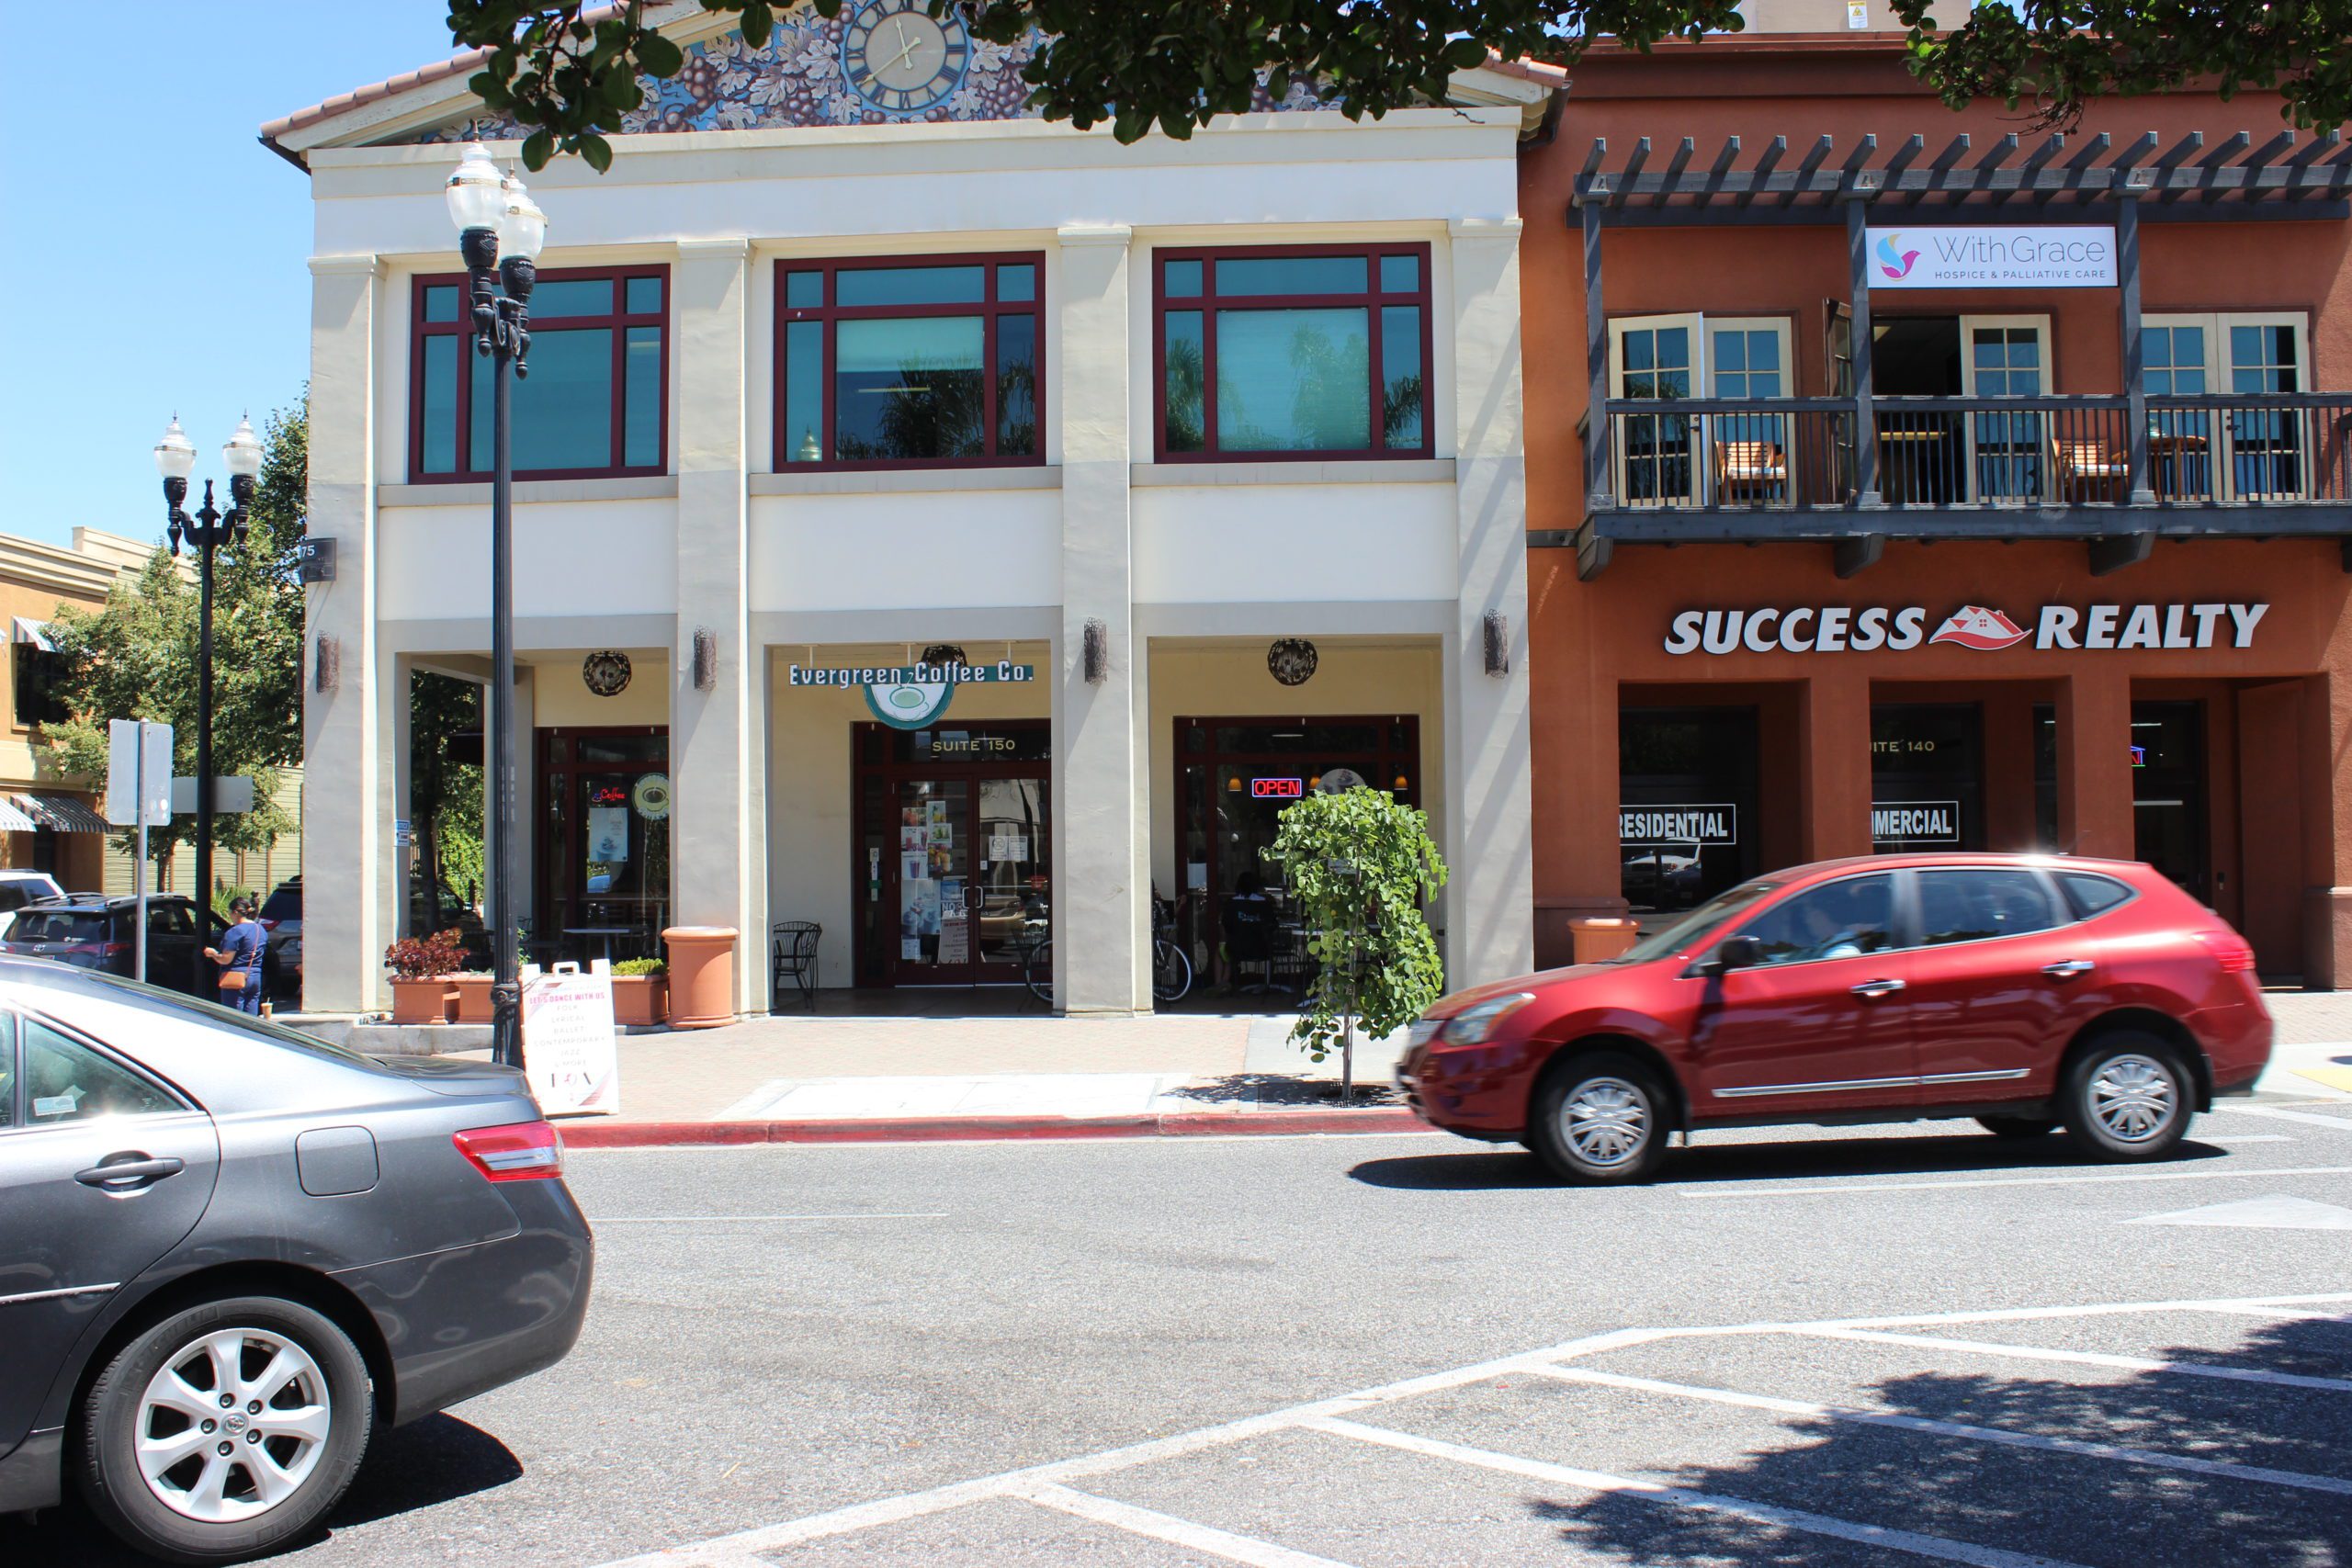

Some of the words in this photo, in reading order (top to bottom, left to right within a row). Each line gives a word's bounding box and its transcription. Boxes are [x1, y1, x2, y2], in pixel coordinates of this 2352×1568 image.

[1935, 270, 1985, 280] HOSPICE
[1991, 270, 1997, 279] &
[2003, 269, 2071, 279] PALLIATIVE
[2075, 269, 2107, 278] CARE
[1664, 606, 1927, 656] SUCCESS
[2035, 603, 2270, 650] REALTY
[789, 664, 903, 690] Evergreen
[914, 660, 985, 683] Coffee
[998, 660, 1034, 682] Co.
[933, 740, 980, 751] SUITE
[989, 739, 1015, 751] 150
[1869, 741, 1900, 752] ITE
[1907, 740, 1935, 752] 140
[601, 787, 626, 801] Coffee
[1254, 780, 1300, 795] OPEN
[1871, 809, 1952, 835] MERCIAL
[549, 993, 572, 1003] DANCE
[574, 992, 594, 1001] WITH
[595, 991, 605, 1000] US
